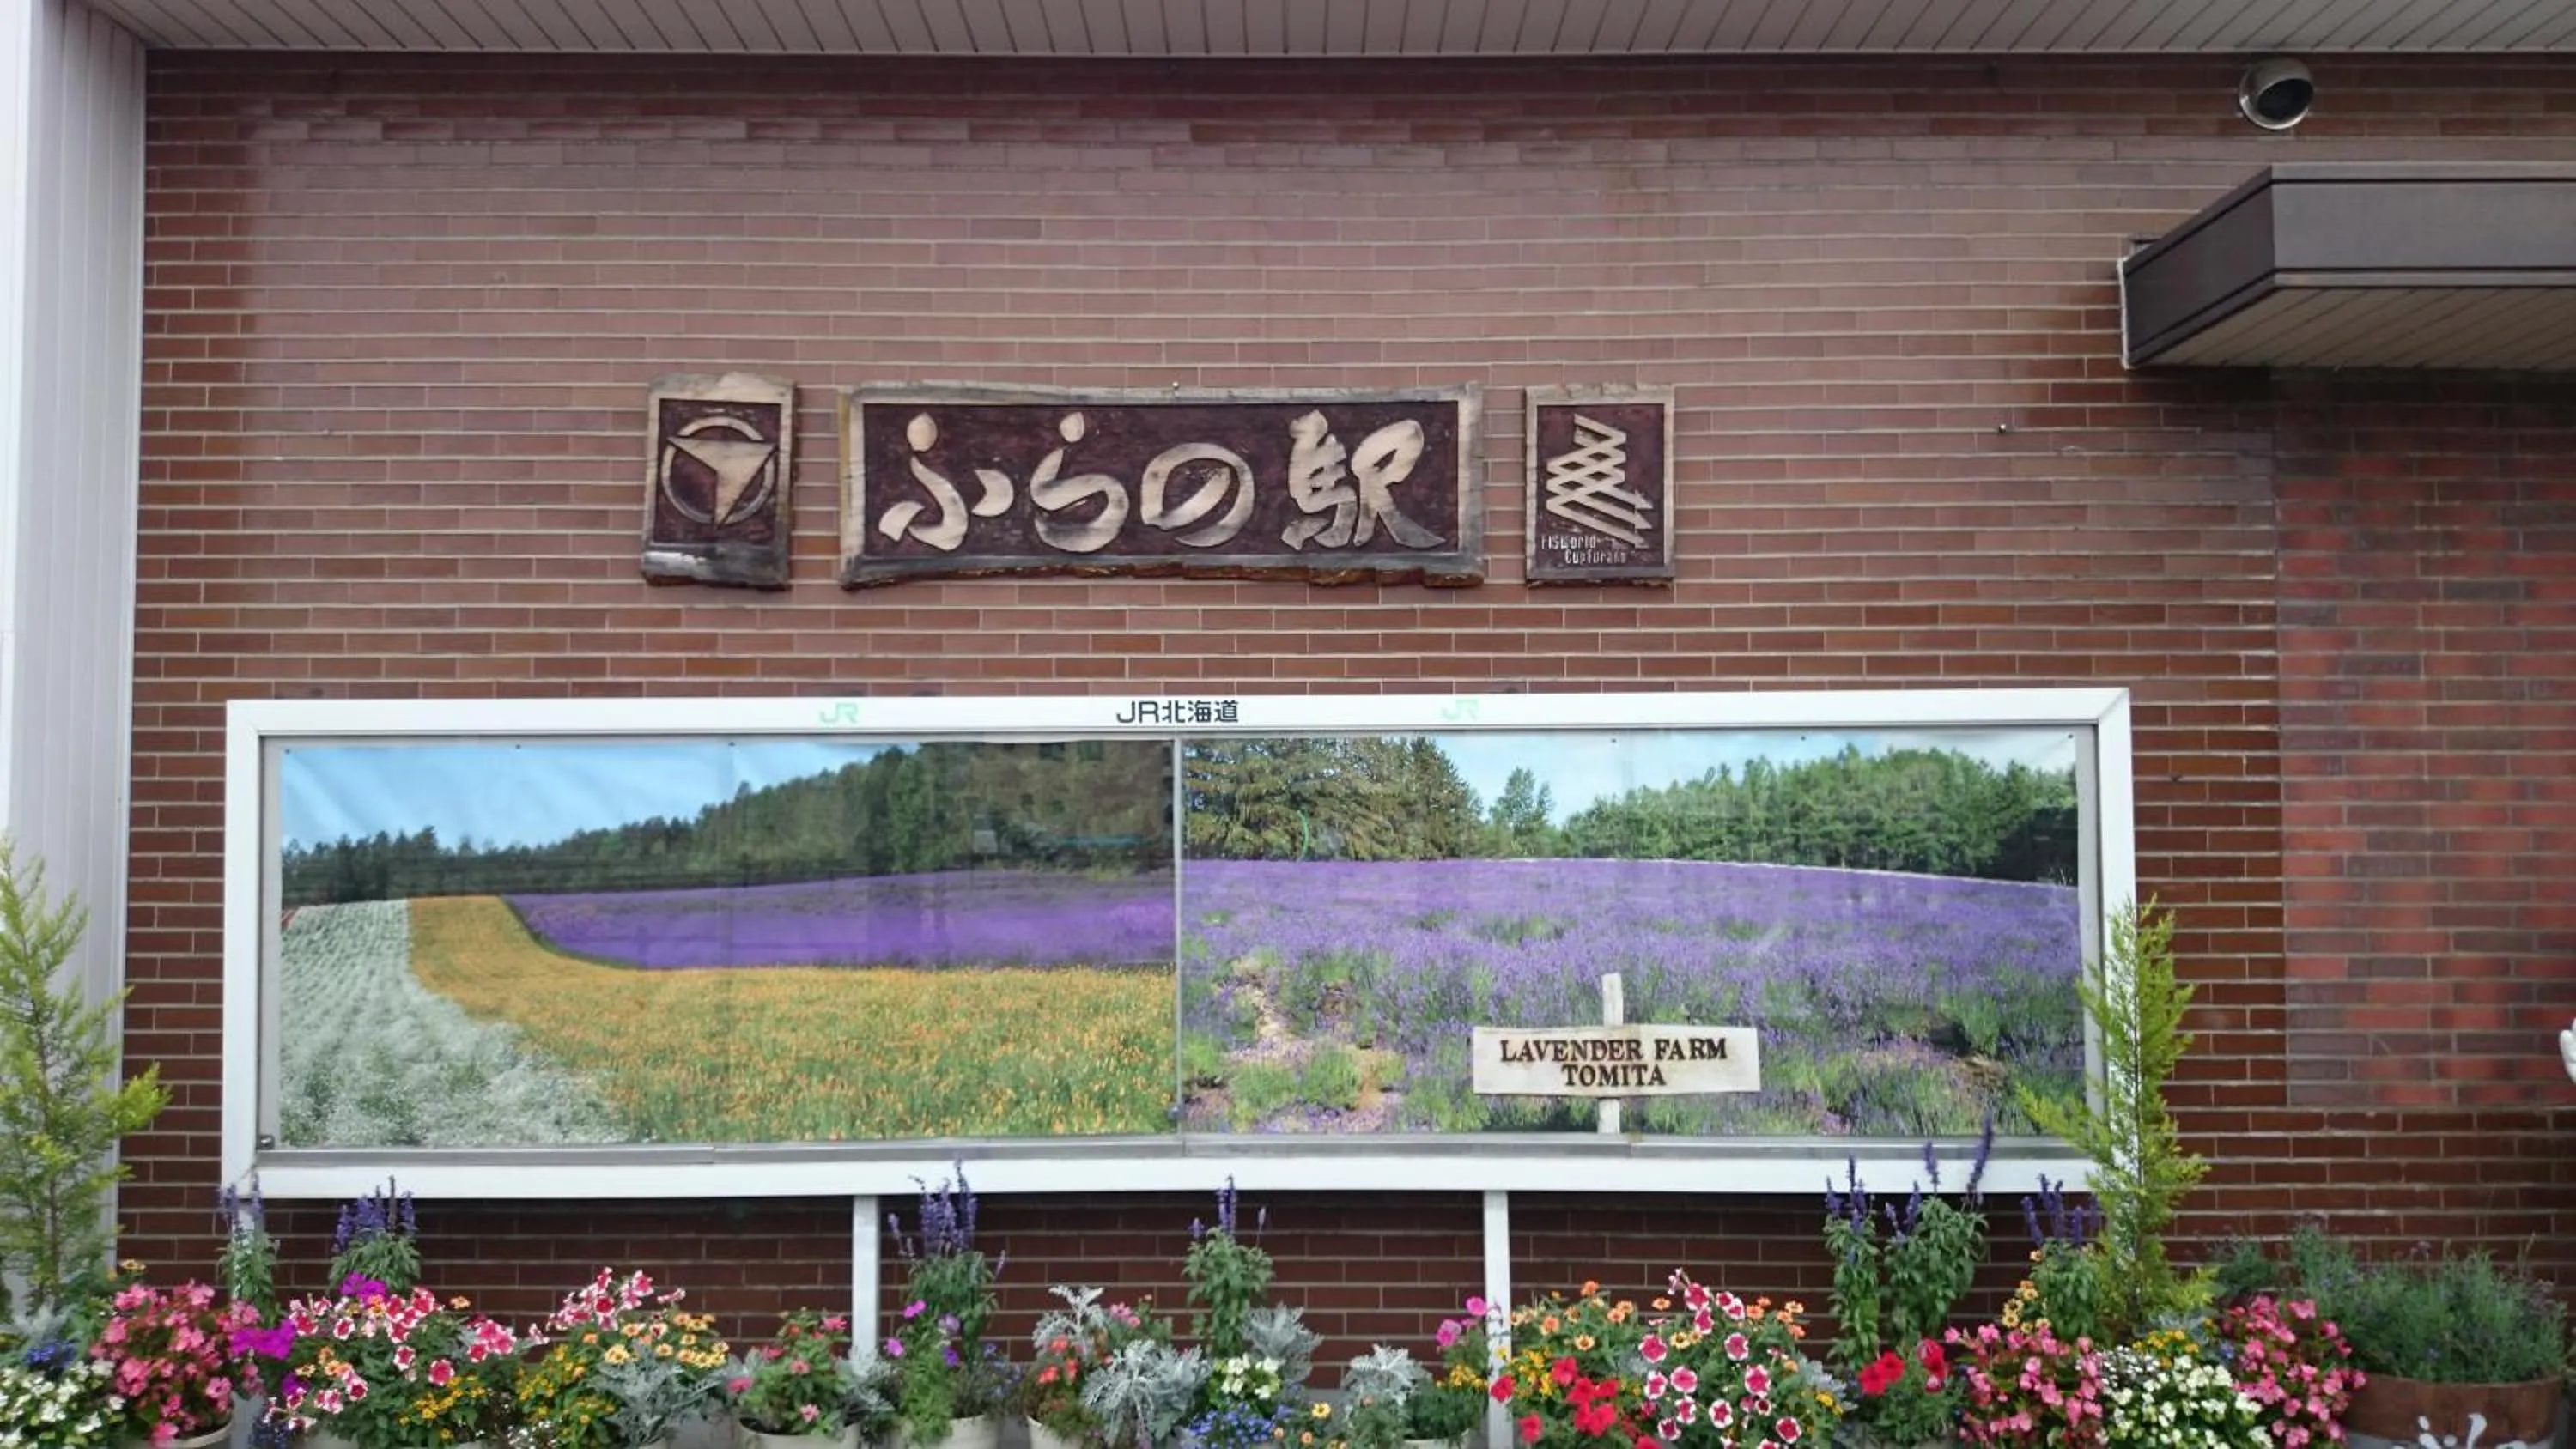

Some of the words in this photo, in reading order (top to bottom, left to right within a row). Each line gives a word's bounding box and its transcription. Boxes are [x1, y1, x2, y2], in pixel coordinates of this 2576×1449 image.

[878, 409, 1447, 553] ふらの駅
[818, 701, 859, 724] JR
[1116, 700, 1239, 724] JR北海道
[1441, 698, 1479, 721] JR
[1500, 1039, 1643, 1062] LAVENDER
[1654, 1037, 1728, 1060] FARM
[1561, 1064, 1667, 1087] TOMITA
